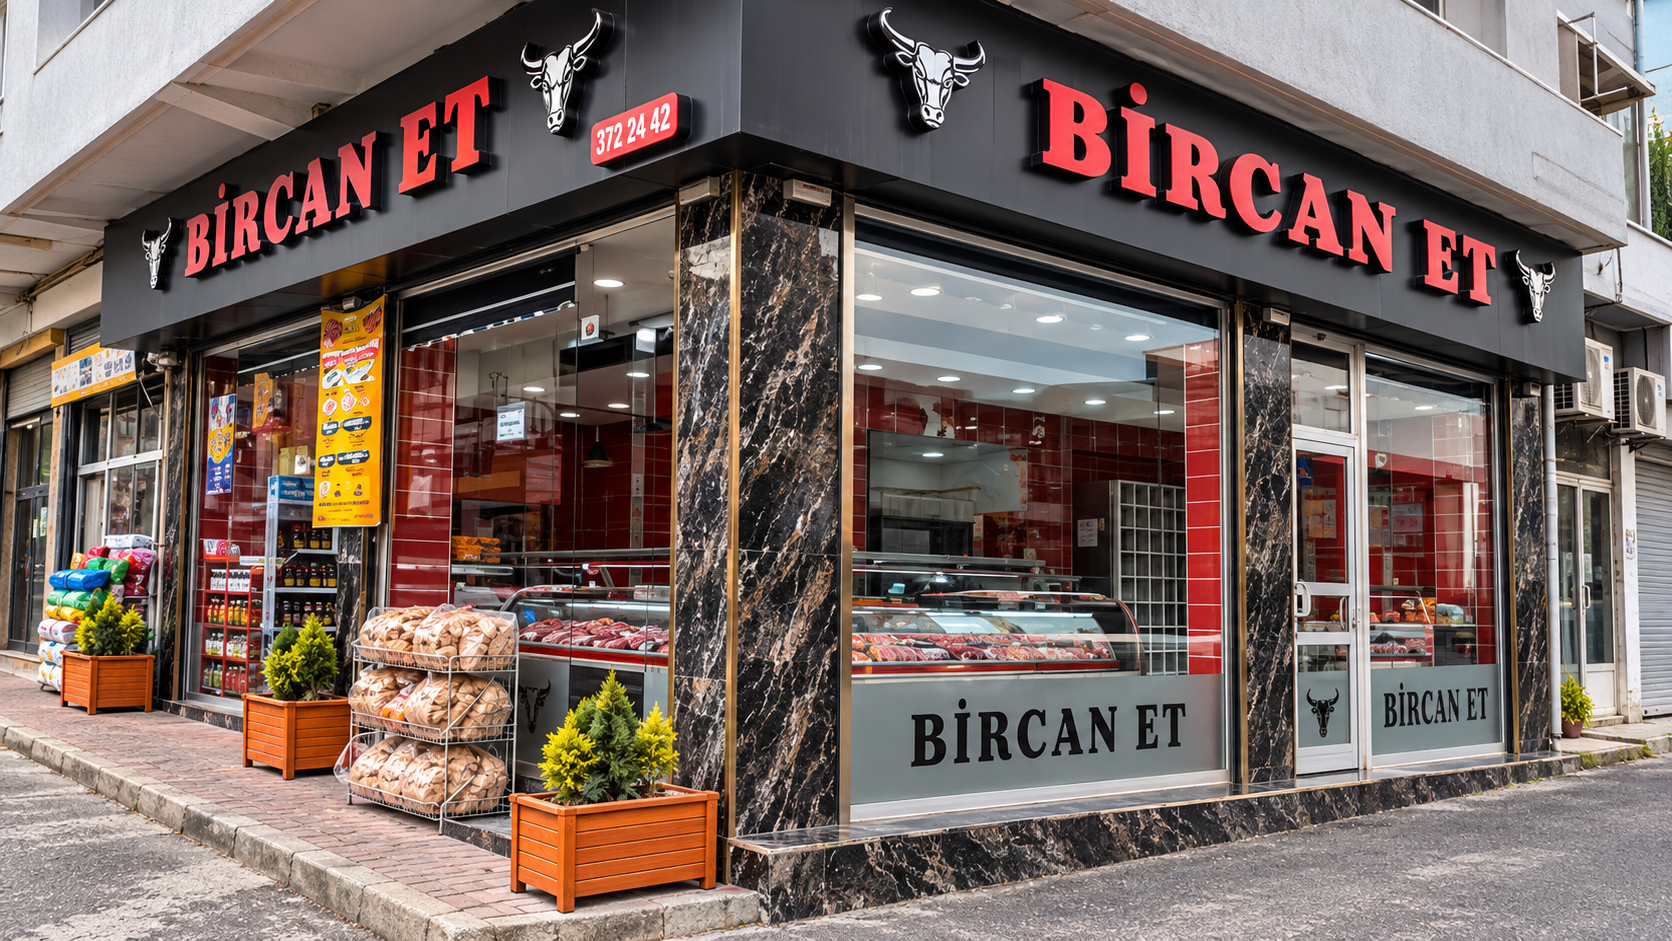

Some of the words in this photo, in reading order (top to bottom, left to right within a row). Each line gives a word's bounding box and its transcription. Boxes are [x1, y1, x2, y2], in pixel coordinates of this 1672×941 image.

[595, 121, 623, 156] 372
[626, 112, 647, 145] 24
[649, 102, 671, 134] 42
[185, 130, 378, 278] BİRCAN
[398, 75, 490, 195] ET
[1041, 77, 1397, 273] BİRCAN
[1423, 218, 1497, 306] ET
[910, 698, 1118, 768] BİRCAN
[1135, 702, 1187, 751] ET
[1383, 682, 1460, 729] BİRCAN
[1466, 687, 1489, 721] ET
